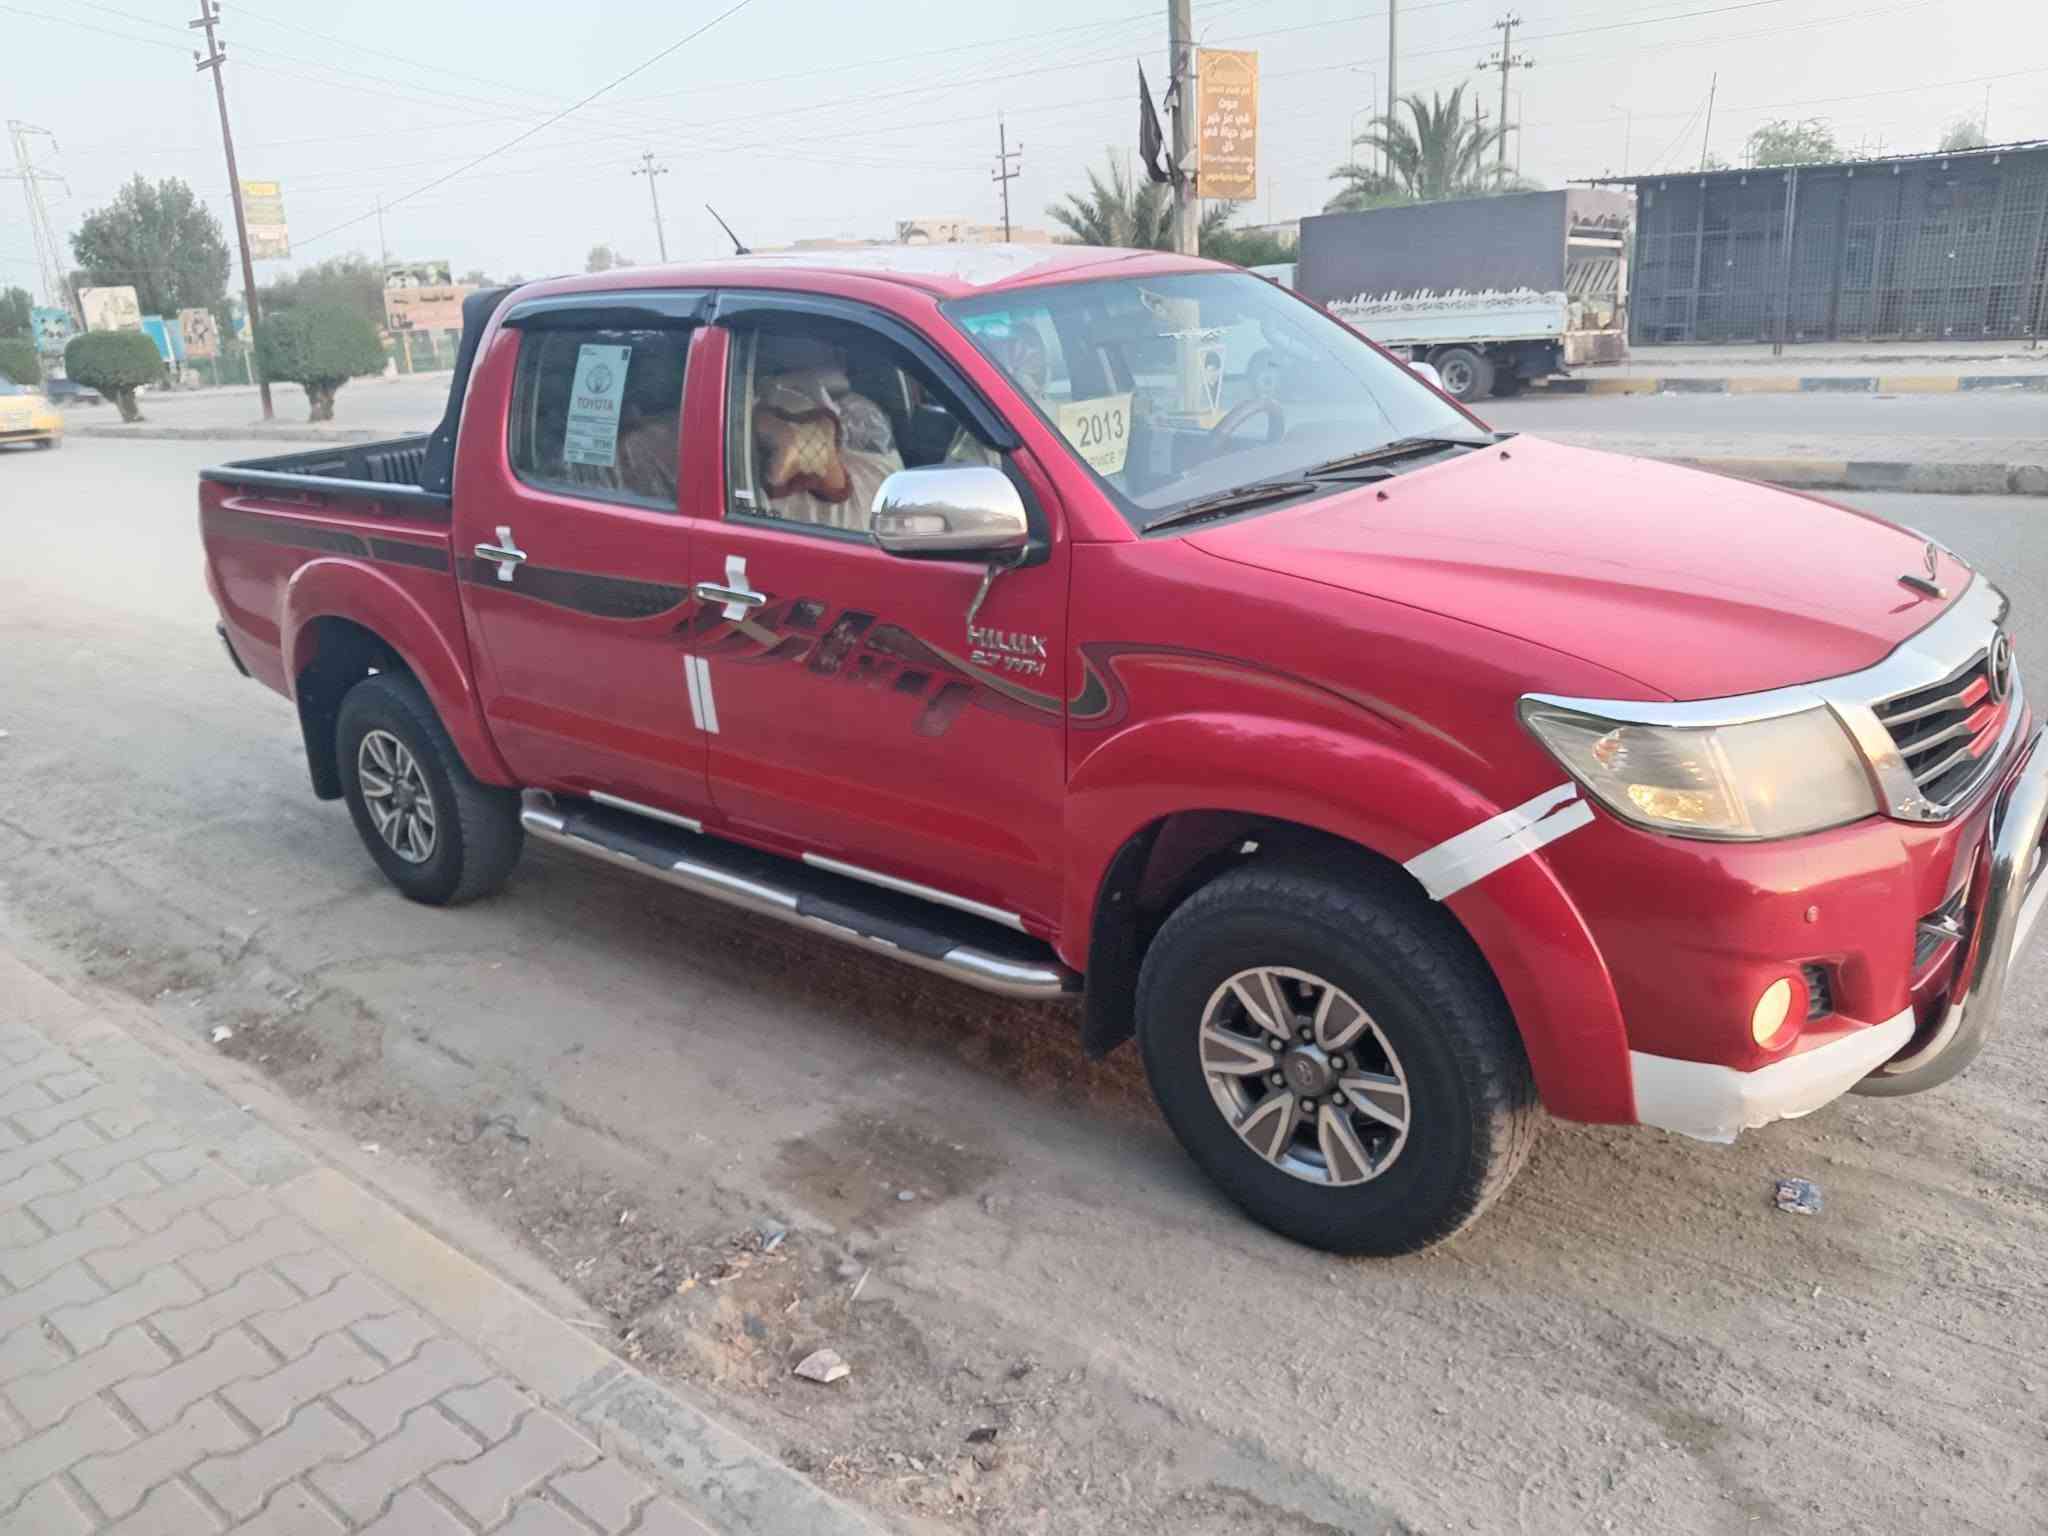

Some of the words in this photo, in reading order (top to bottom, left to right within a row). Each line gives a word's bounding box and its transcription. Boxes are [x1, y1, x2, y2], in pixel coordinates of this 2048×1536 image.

[576, 397, 613, 410] TOYOTA
[1077, 409, 1124, 447] 2013
[968, 625, 1047, 657] HILUX
